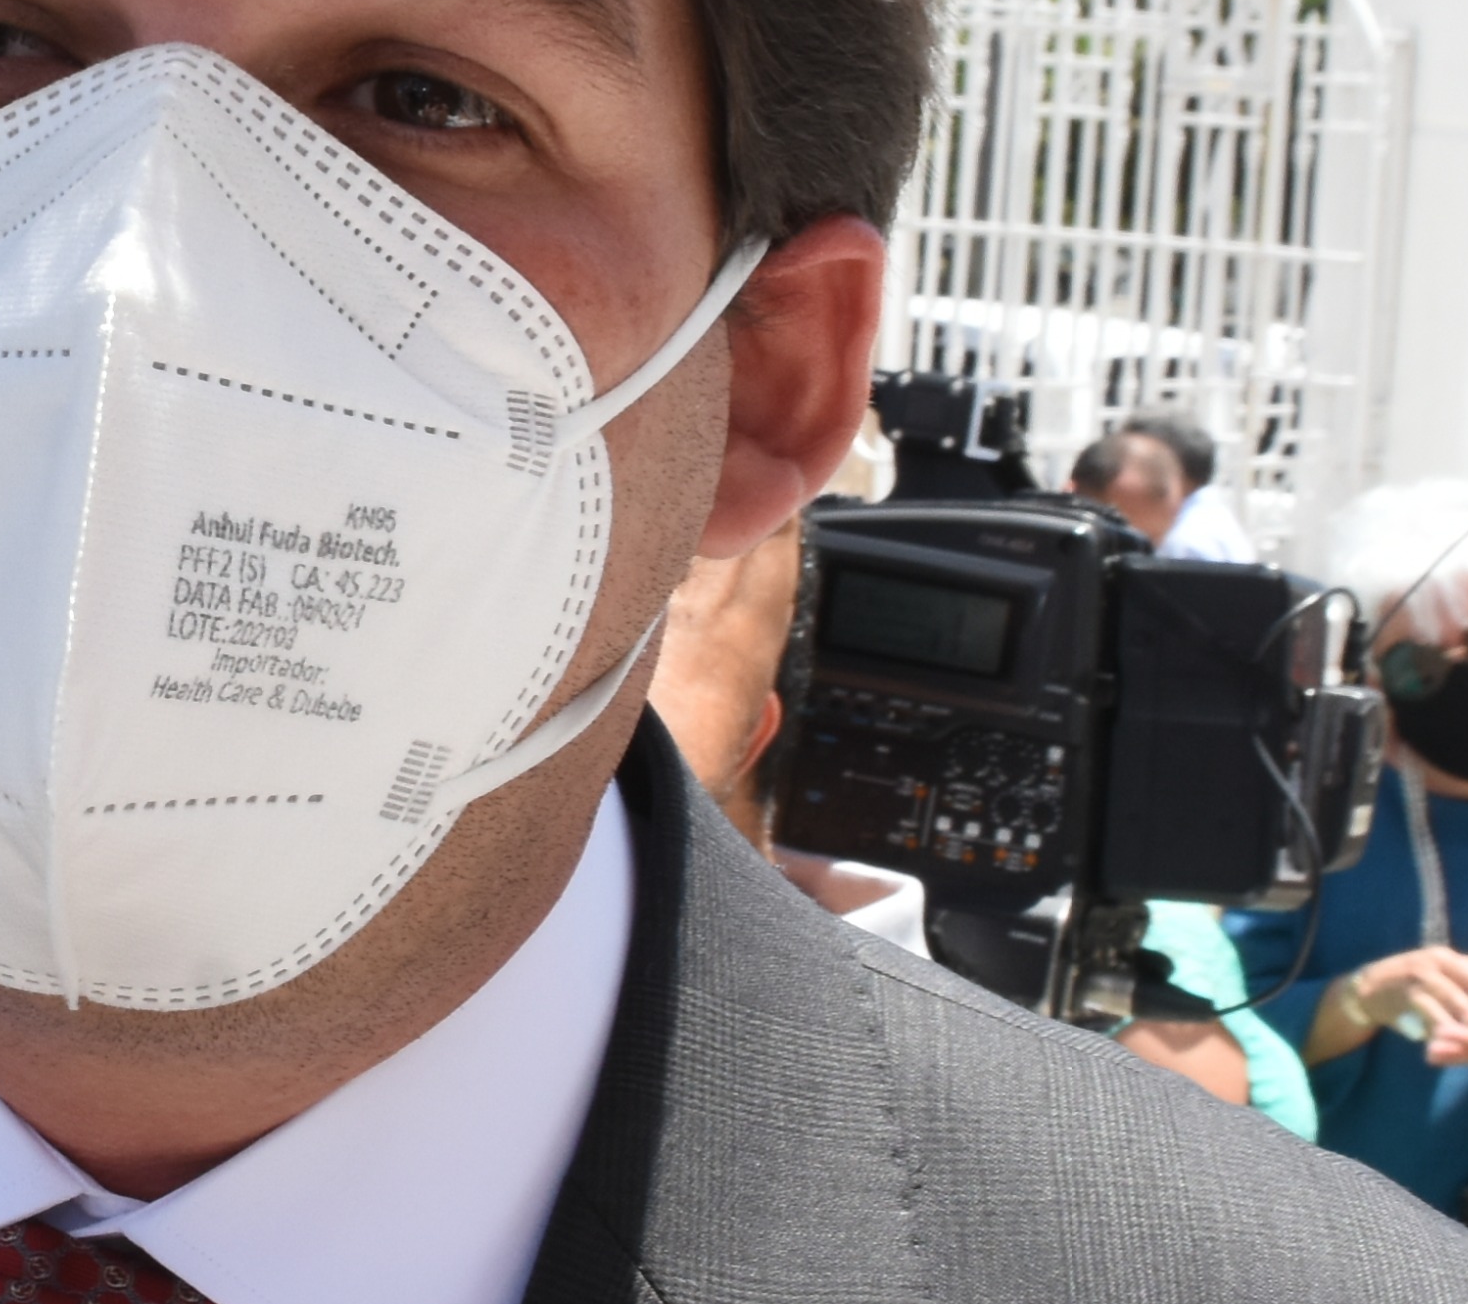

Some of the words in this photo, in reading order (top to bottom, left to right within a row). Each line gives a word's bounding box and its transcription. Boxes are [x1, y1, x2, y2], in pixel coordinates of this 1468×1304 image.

[345, 503, 397, 533] KN95
[191, 510, 254, 545] Anhui
[259, 520, 311, 554] Fuda
[316, 531, 400, 568] Biotech.
[178, 544, 232, 578] PFF2
[174, 577, 231, 612] DATA
[210, 647, 330, 685] Importador:
[150, 675, 213, 703] Health
[217, 681, 263, 706] Care
[267, 684, 285, 710] &
